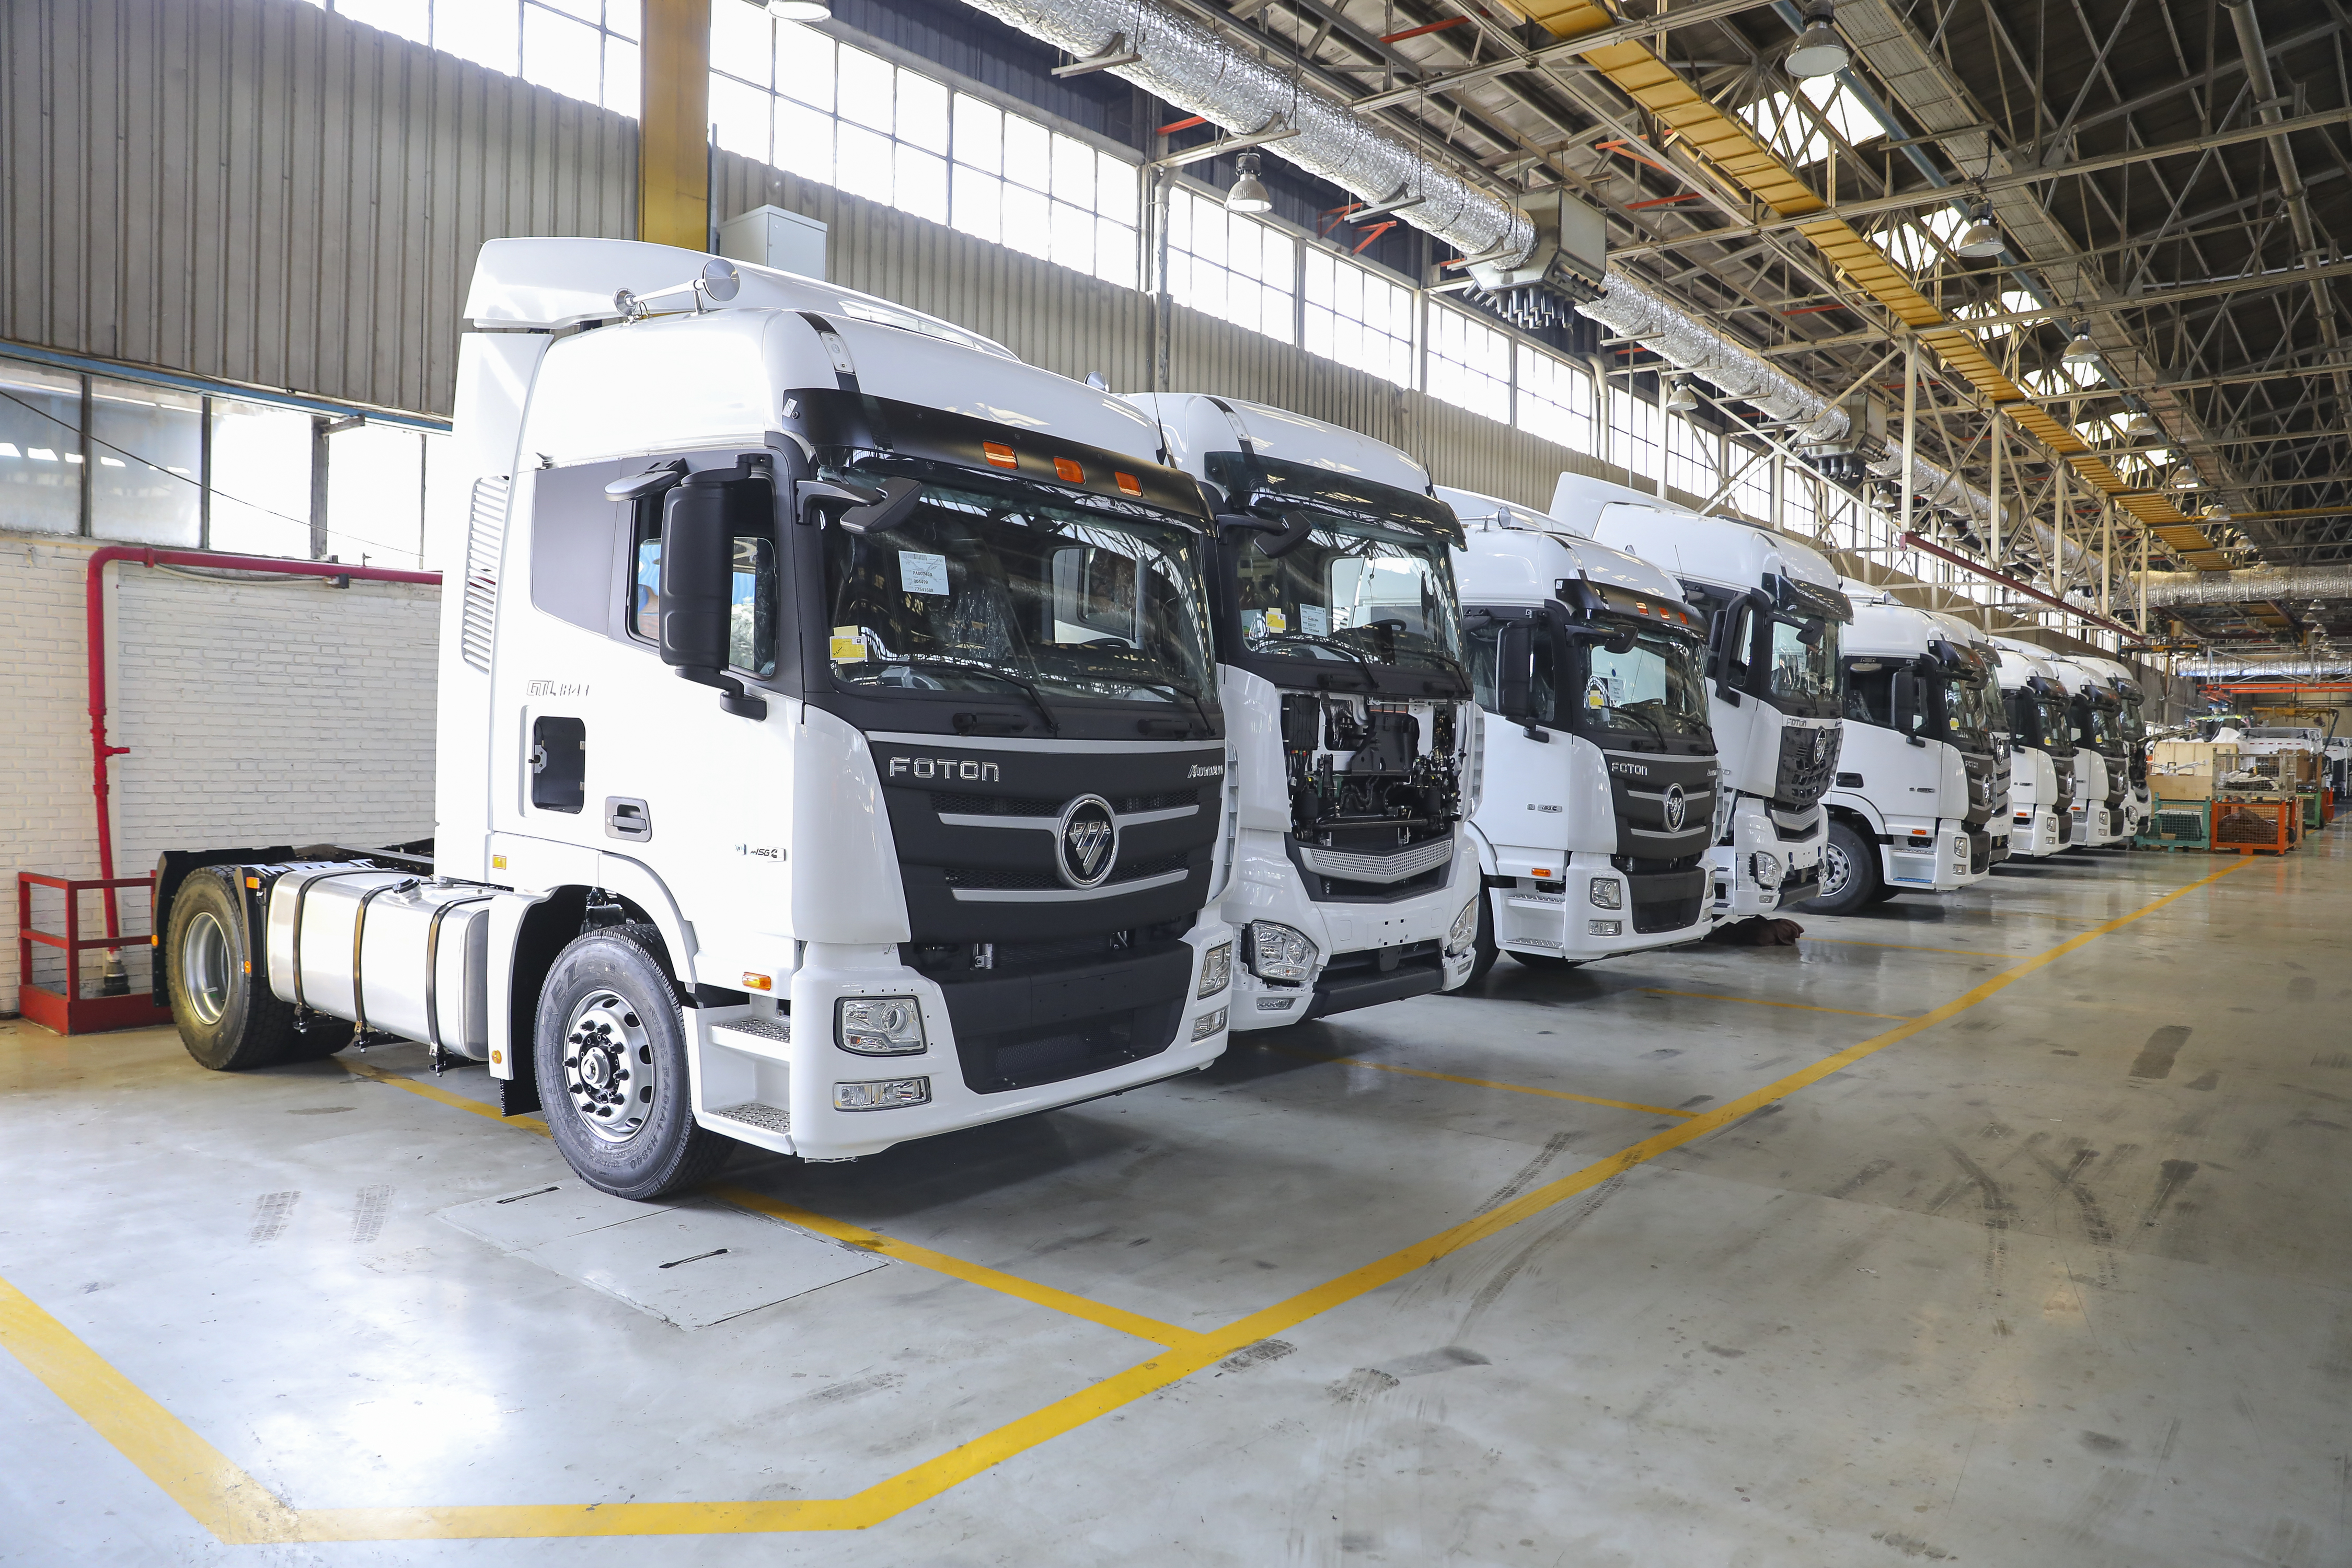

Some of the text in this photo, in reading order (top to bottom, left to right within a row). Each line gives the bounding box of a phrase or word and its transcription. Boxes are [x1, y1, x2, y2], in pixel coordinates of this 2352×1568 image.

[889, 757, 1000, 782] FOTON
[1611, 762, 1647, 776] FOTON
[755, 848, 770, 857] ISG
[656, 1065, 671, 1132] RADIAL
[630, 1135, 659, 1170] HS840
